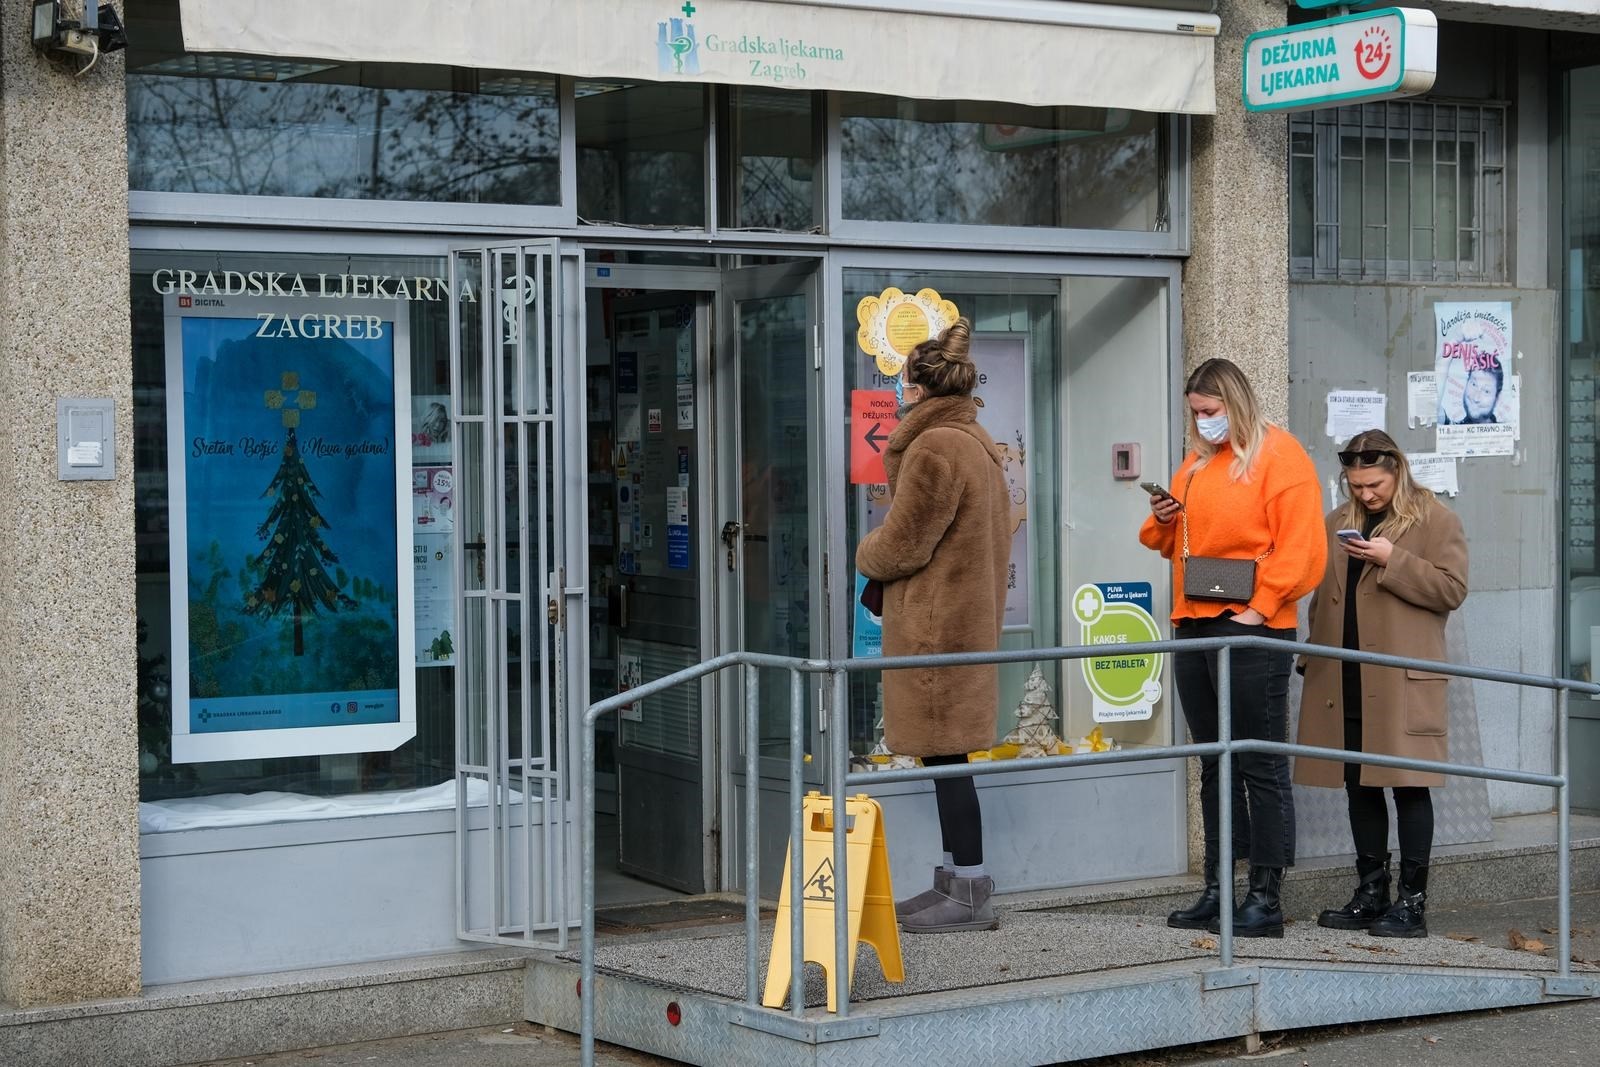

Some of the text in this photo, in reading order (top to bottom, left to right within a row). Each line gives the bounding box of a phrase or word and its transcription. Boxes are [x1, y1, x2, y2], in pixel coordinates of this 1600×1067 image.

[706, 33, 843, 61] Gradska ljekarna
[1261, 36, 1336, 66] DEŽURNA
[1365, 42, 1383, 63] 24
[749, 60, 806, 81] Zagreb
[1261, 63, 1340, 96] LJEKARNA
[152, 268, 477, 303] GRADSKA LJEKARNA
[195, 299, 225, 307] DIGITAL
[256, 312, 383, 340] ZAGREB
[1442, 342, 1479, 359] DENIS
[862, 411, 897, 419] DEŽURSTV
[192, 437, 234, 458] Sretan
[239, 436, 278, 460] Božić
[307, 437, 341, 457] Nova
[1093, 634, 1127, 644] KAKO SE
[1095, 661, 1110, 670] BEZ
